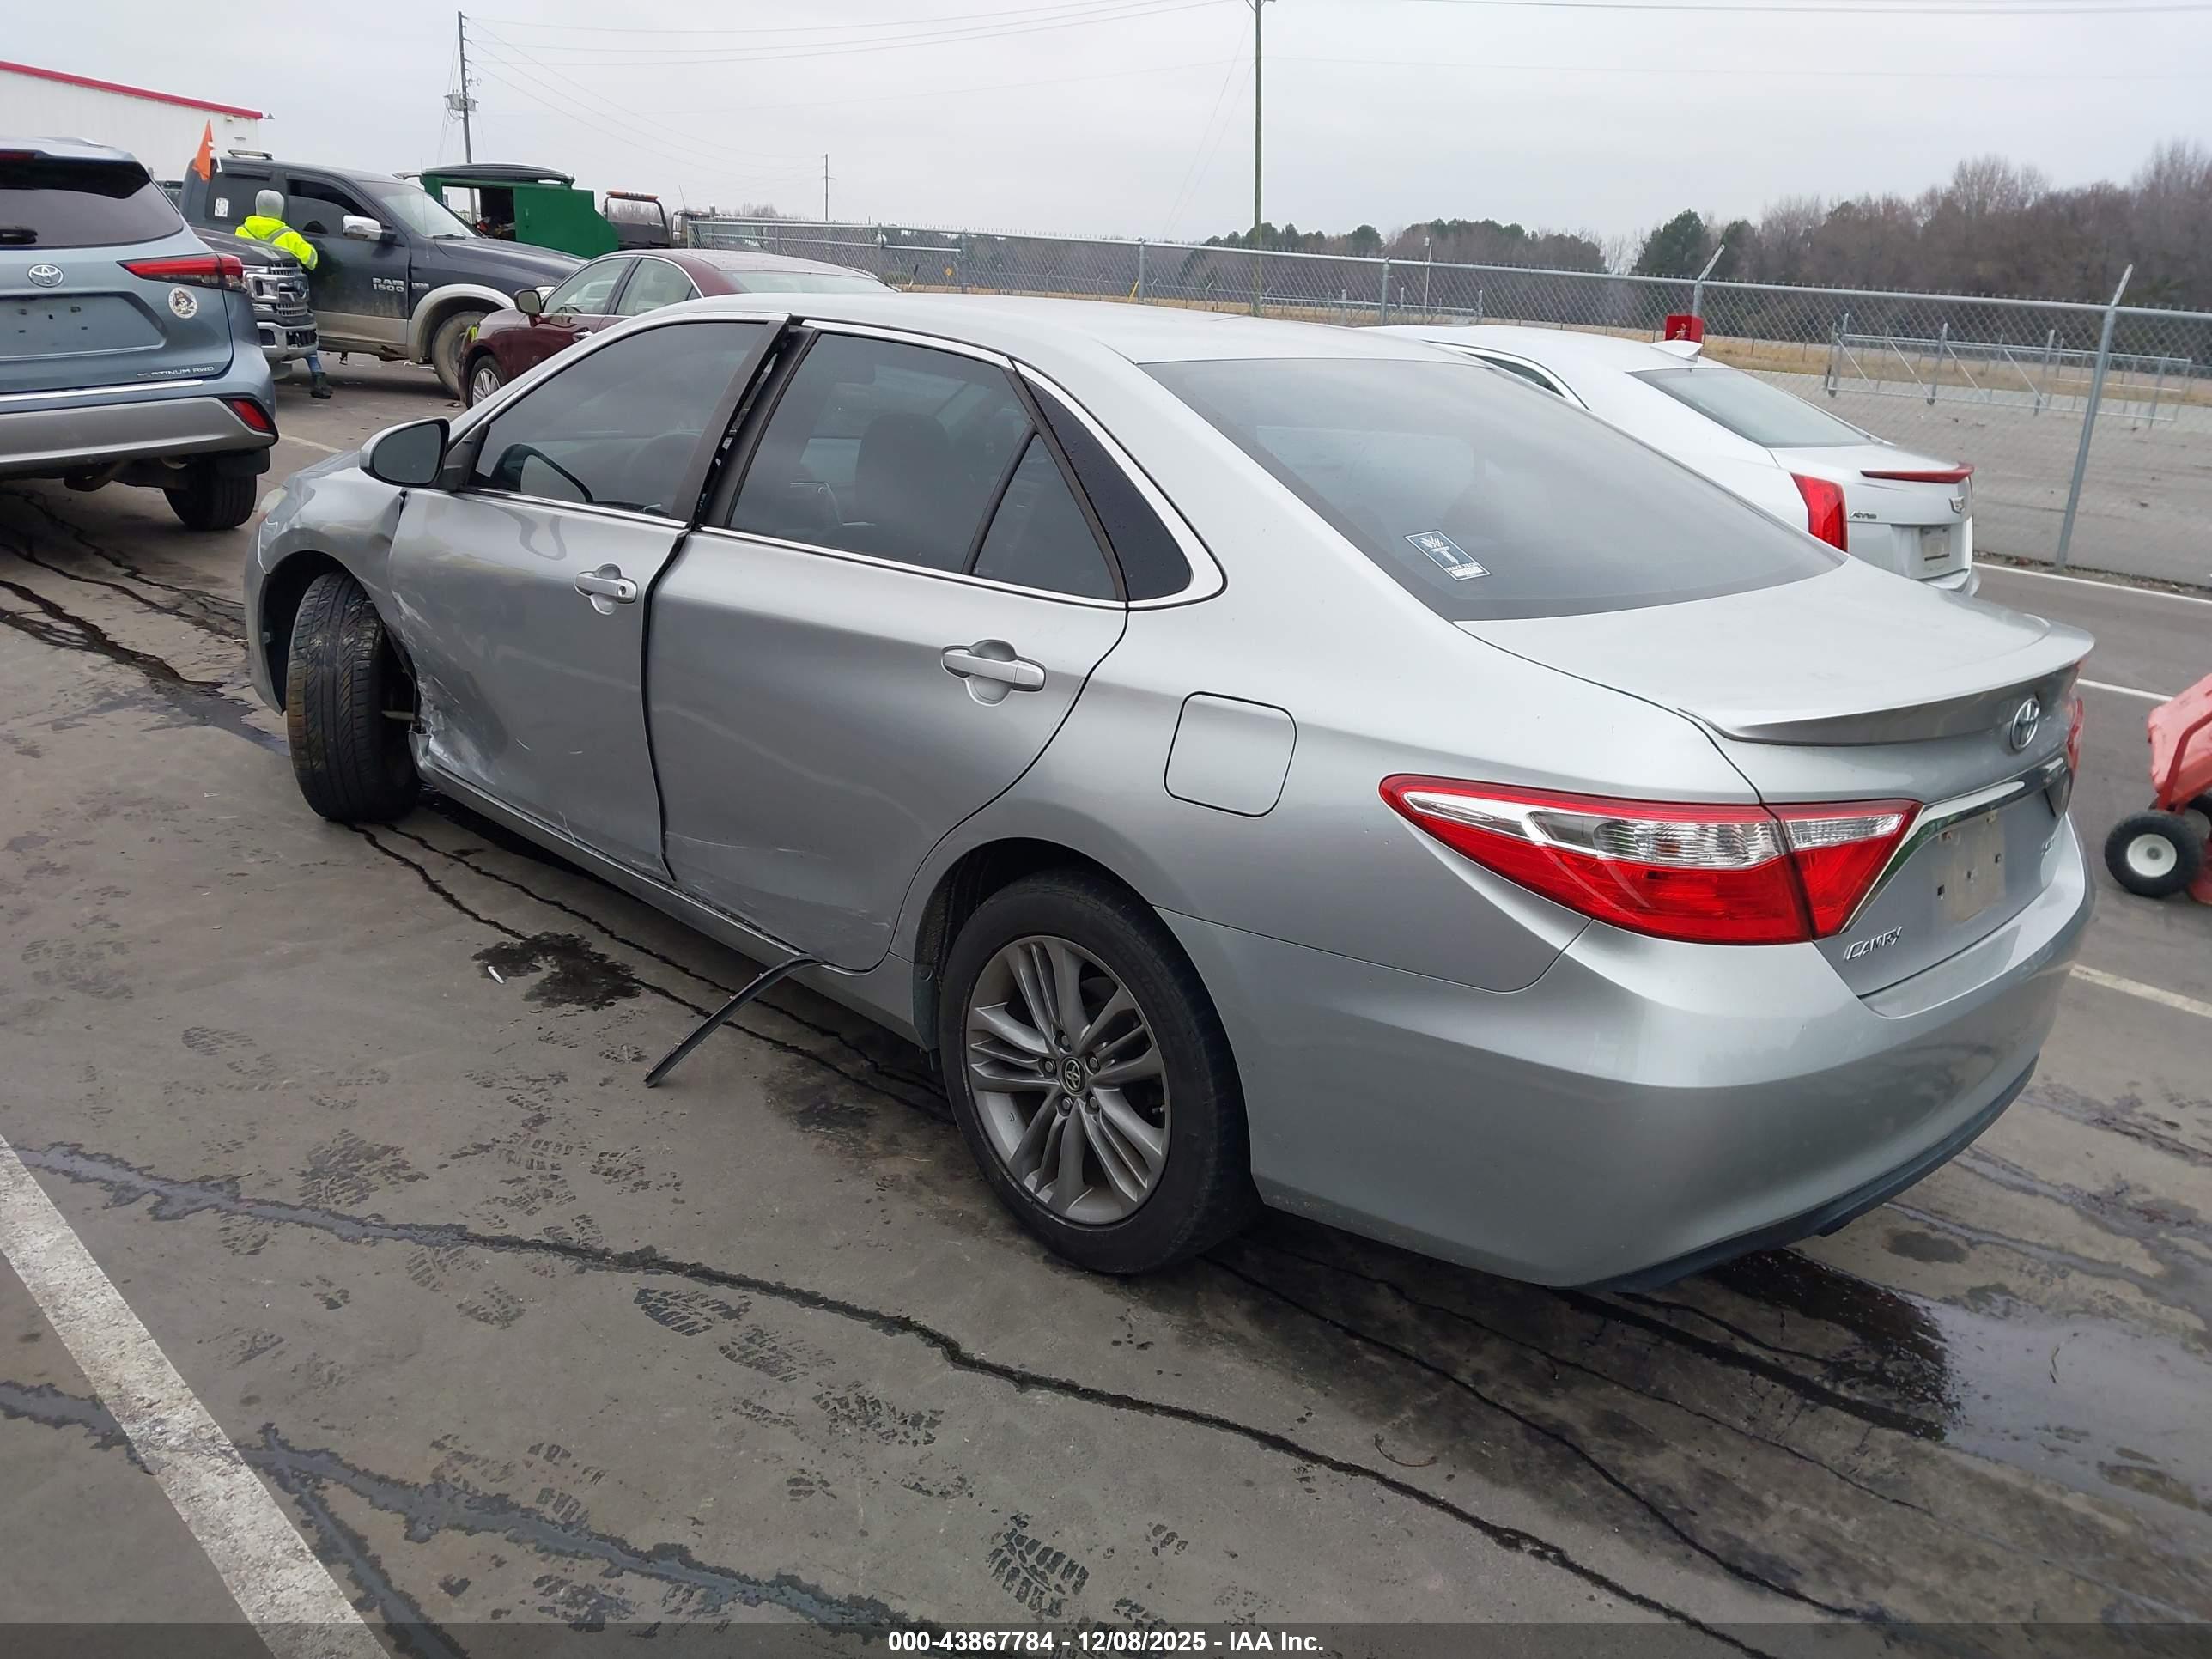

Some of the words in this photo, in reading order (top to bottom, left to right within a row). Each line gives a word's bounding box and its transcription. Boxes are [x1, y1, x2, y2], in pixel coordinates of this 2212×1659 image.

[372, 277, 404, 286] RAM
[373, 283, 404, 293] 1500
[1843, 926, 1903, 961] CAMRY
